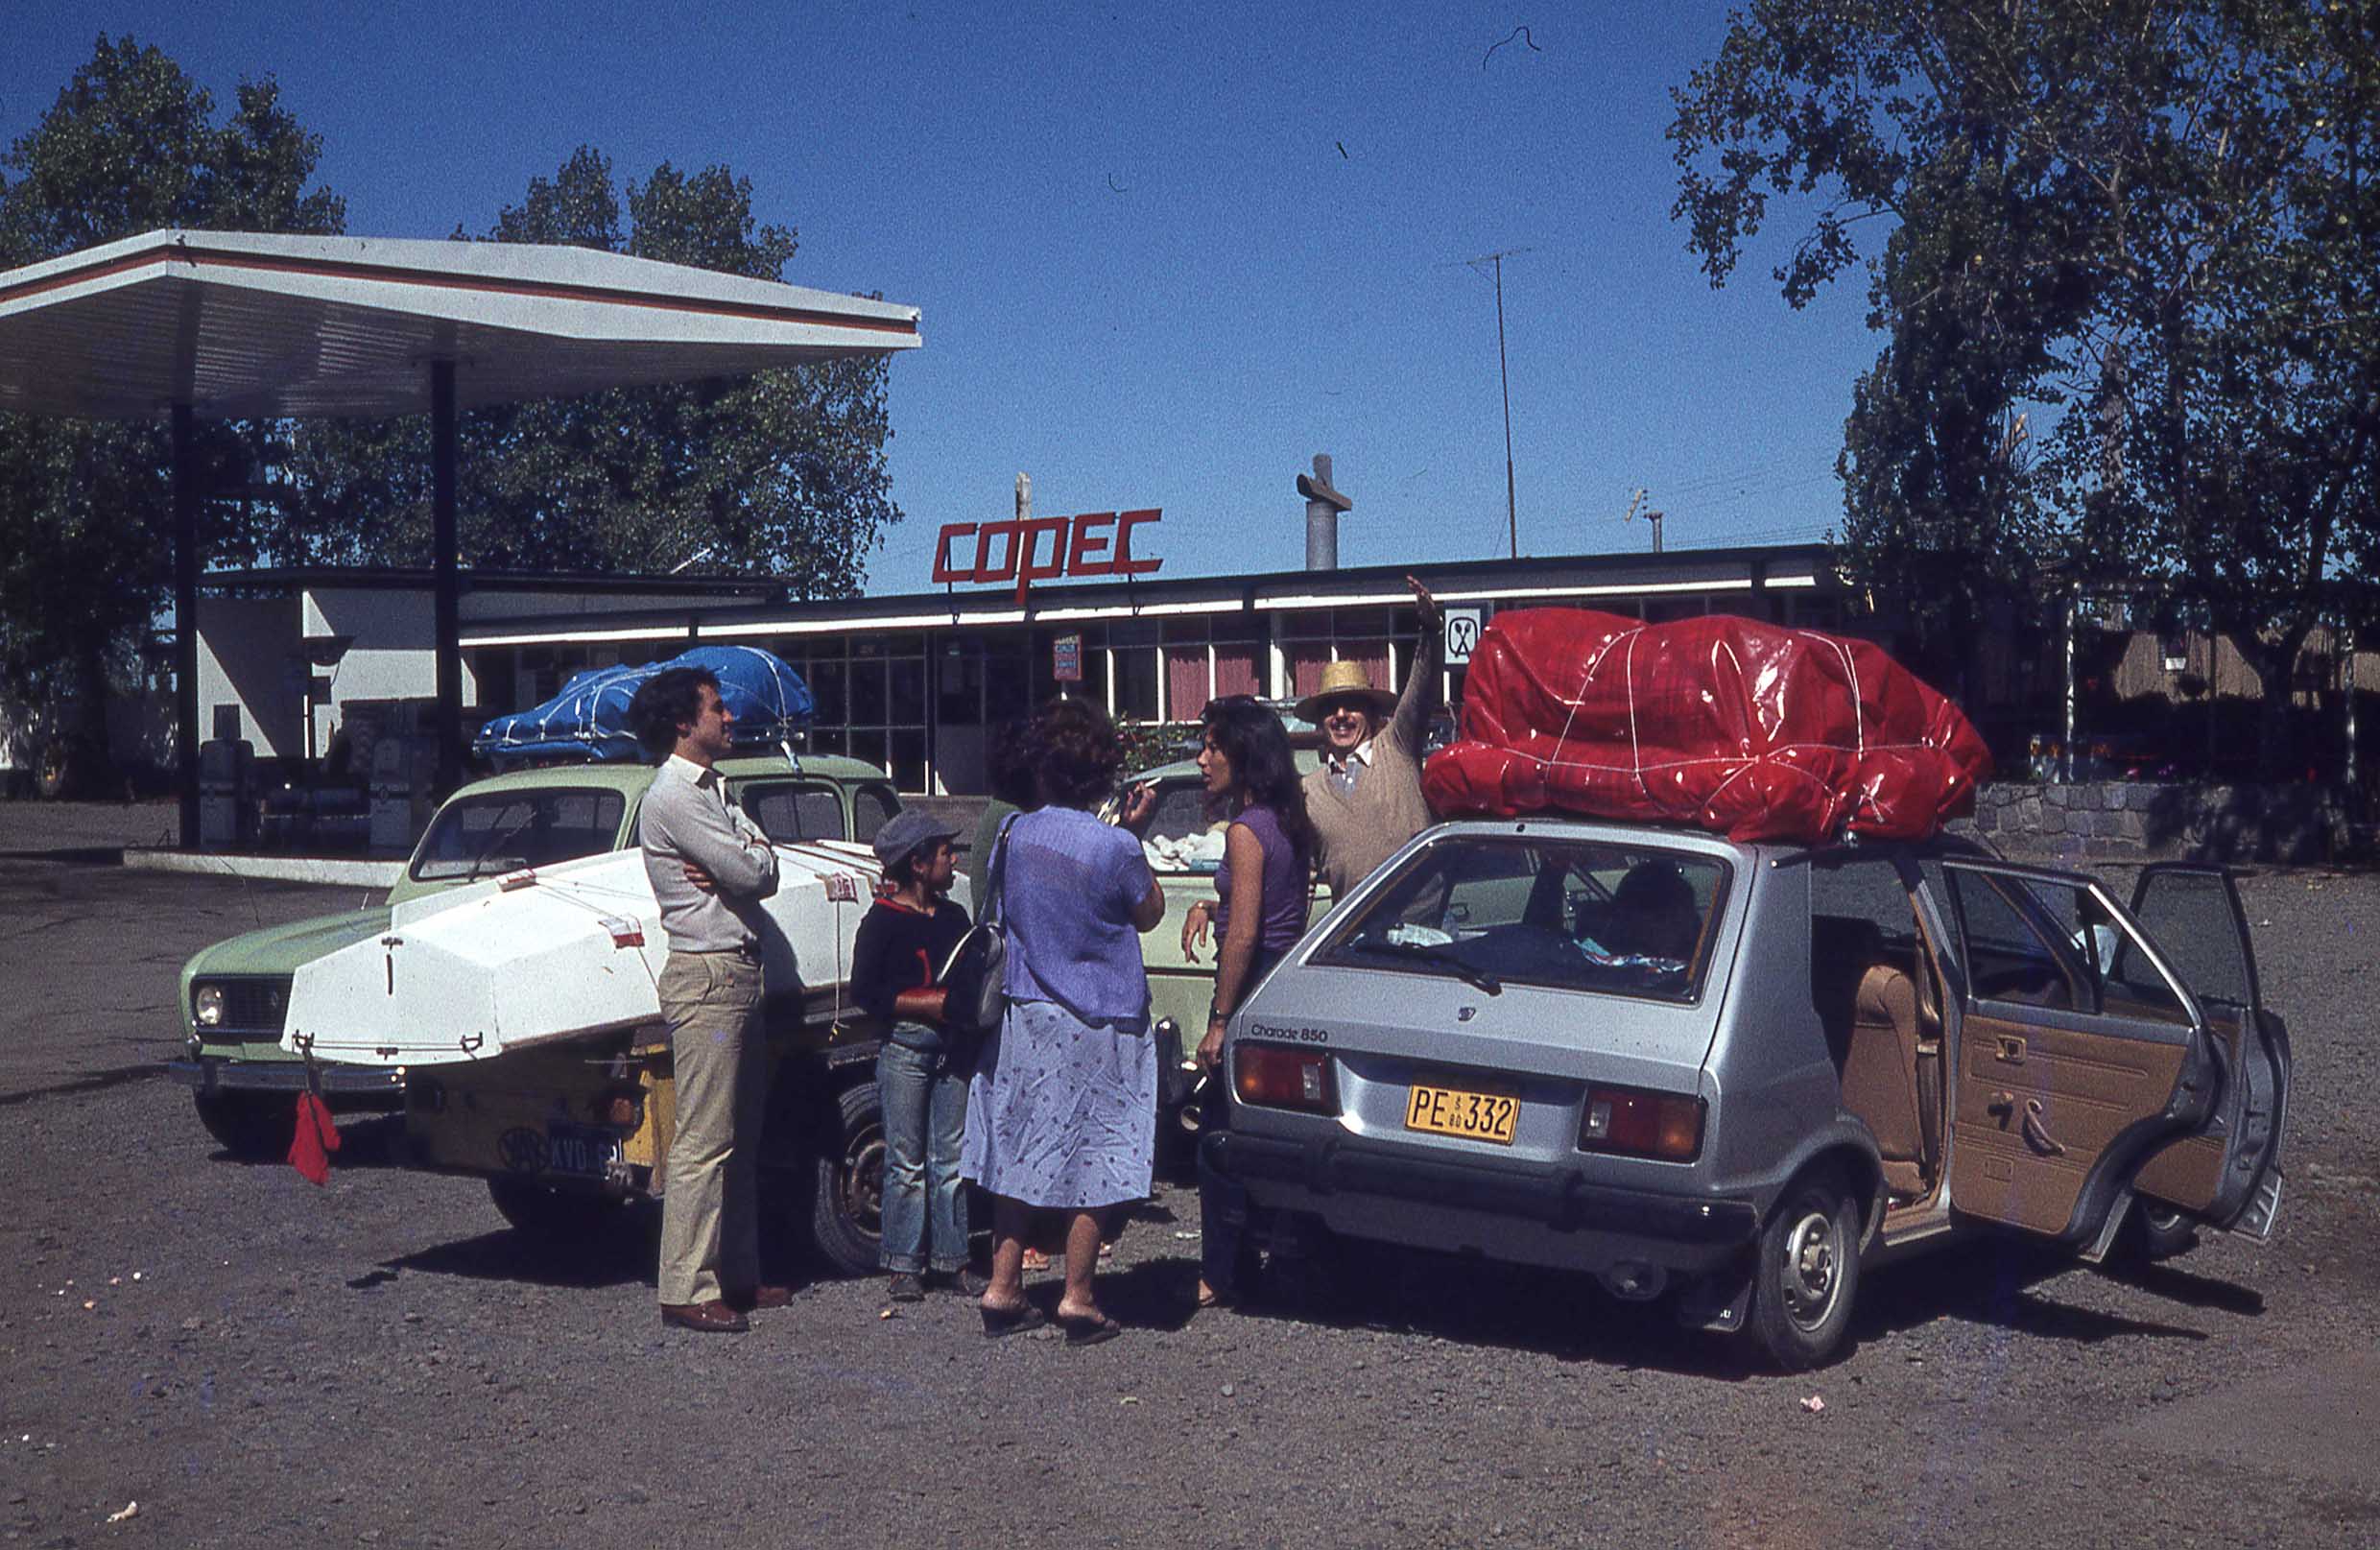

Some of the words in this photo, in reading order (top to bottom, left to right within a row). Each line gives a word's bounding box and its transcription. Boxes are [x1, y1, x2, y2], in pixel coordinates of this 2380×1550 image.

[1251, 1023, 1298, 1040] Charade
[1300, 1028, 1328, 1043] 850
[1412, 1088, 1449, 1128] PE
[1464, 1095, 1512, 1135] 332
